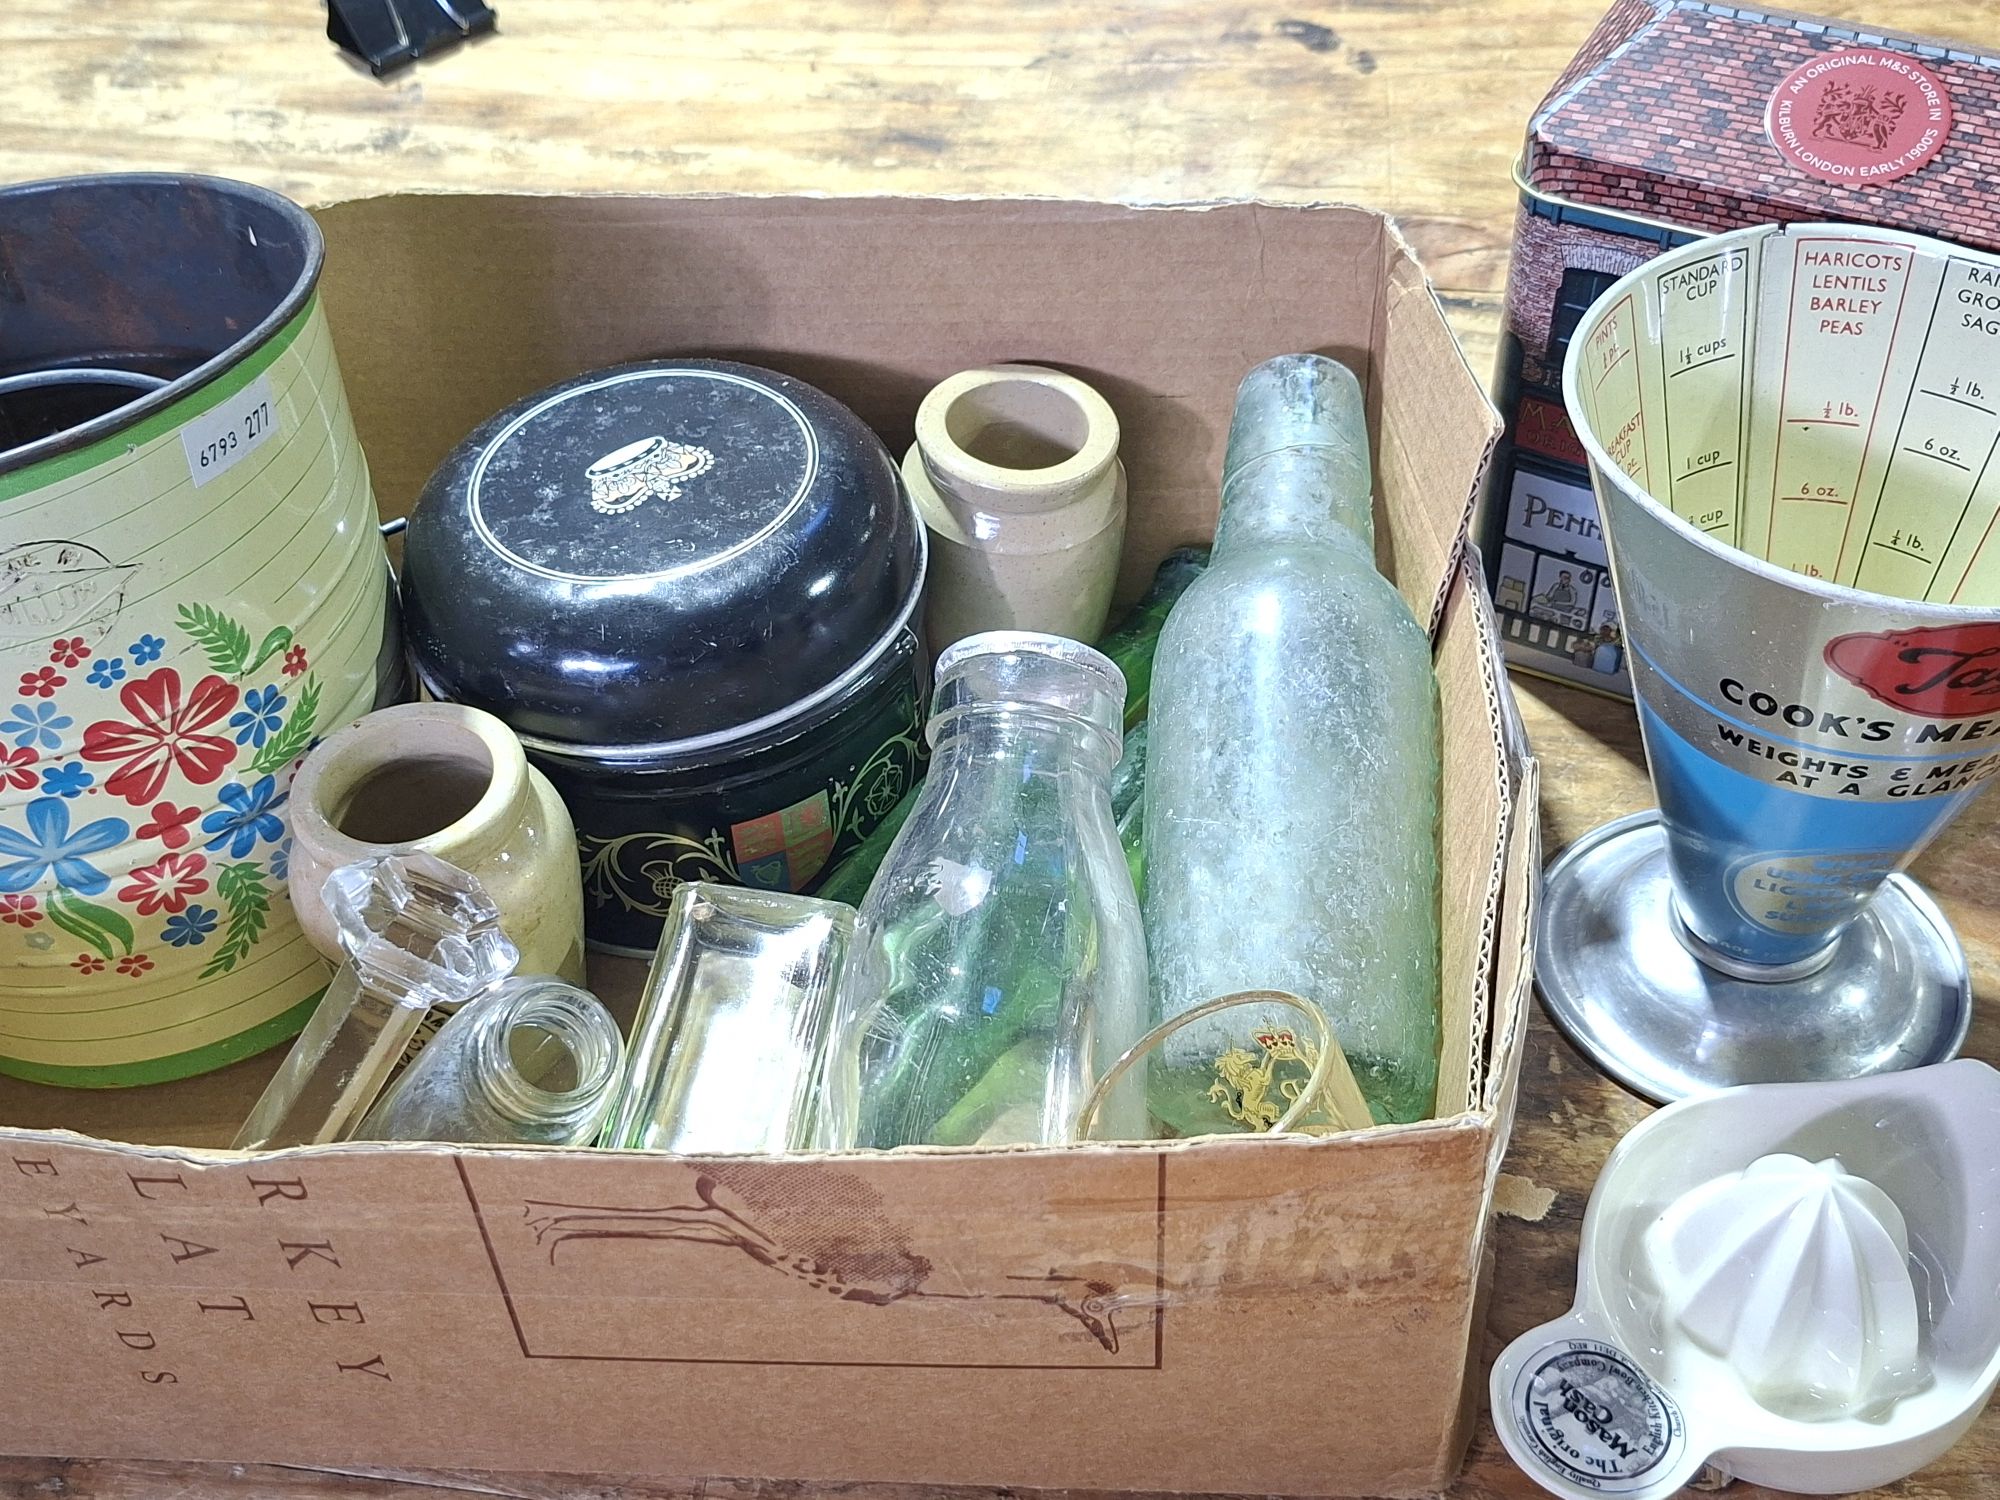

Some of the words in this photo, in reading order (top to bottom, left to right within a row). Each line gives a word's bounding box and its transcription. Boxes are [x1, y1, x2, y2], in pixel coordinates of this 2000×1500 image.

[1789, 76, 1809, 95] AN
[1806, 55, 1876, 79] ORIGINAL
[1879, 57, 1910, 75] M&S
[1907, 71, 1941, 106] STORE
[1928, 107, 1942, 121] IN
[1778, 99, 1801, 149] KILBURN
[1794, 146, 1856, 177] LONDON
[1860, 157, 1906, 177] EARLY
[1803, 250, 1903, 272] HARICOTS
[1661, 257, 1744, 295] STANDARD
[1812, 276, 1888, 293] LENTILS
[1968, 267, 2000, 287] RAI
[1686, 280, 1717, 301] CUP
[1958, 289, 2000, 311] GRO
[1810, 297, 1883, 315] BARLEY
[1595, 315, 1618, 350] PINTS
[1819, 320, 1864, 336] PEAS
[1697, 338, 1727, 357] cups
[1965, 381, 1984, 399] lb.
[1838, 402, 1859, 417] lb.
[199, 431, 238, 468] 6793
[244, 402, 271, 440] 277
[1607, 412, 1640, 456] REAKFAST
[1615, 439, 1631, 465] CUP
[1697, 450, 1720, 466] cup
[1924, 438, 1934, 451] 6
[1939, 446, 1960, 461] oz.
[1801, 483, 1810, 496] 6
[1817, 486, 1839, 498] oz.
[1700, 509, 1723, 524] cup
[1906, 534, 1924, 551] lb.
[1719, 678, 1895, 742] COOK'S
[1717, 723, 1869, 779] WEIGHTS
[1925, 754, 2000, 780] MEA
[1775, 769, 1820, 789] AT
[1837, 782, 1861, 796] A
[1556, 1358, 1606, 1373] Company
[1608, 1366, 1635, 1387] Bowl
[1559, 1378, 1613, 1425] Cash
[1637, 1384, 1661, 1421] Kitchen
[1533, 1400, 1580, 1459] original
[1563, 1398, 1638, 1460] Mason
[1642, 1420, 1664, 1457] English
[1537, 1449, 1566, 1476] English
[1585, 1456, 1623, 1475] The
[1568, 1470, 1601, 1488] Quality
